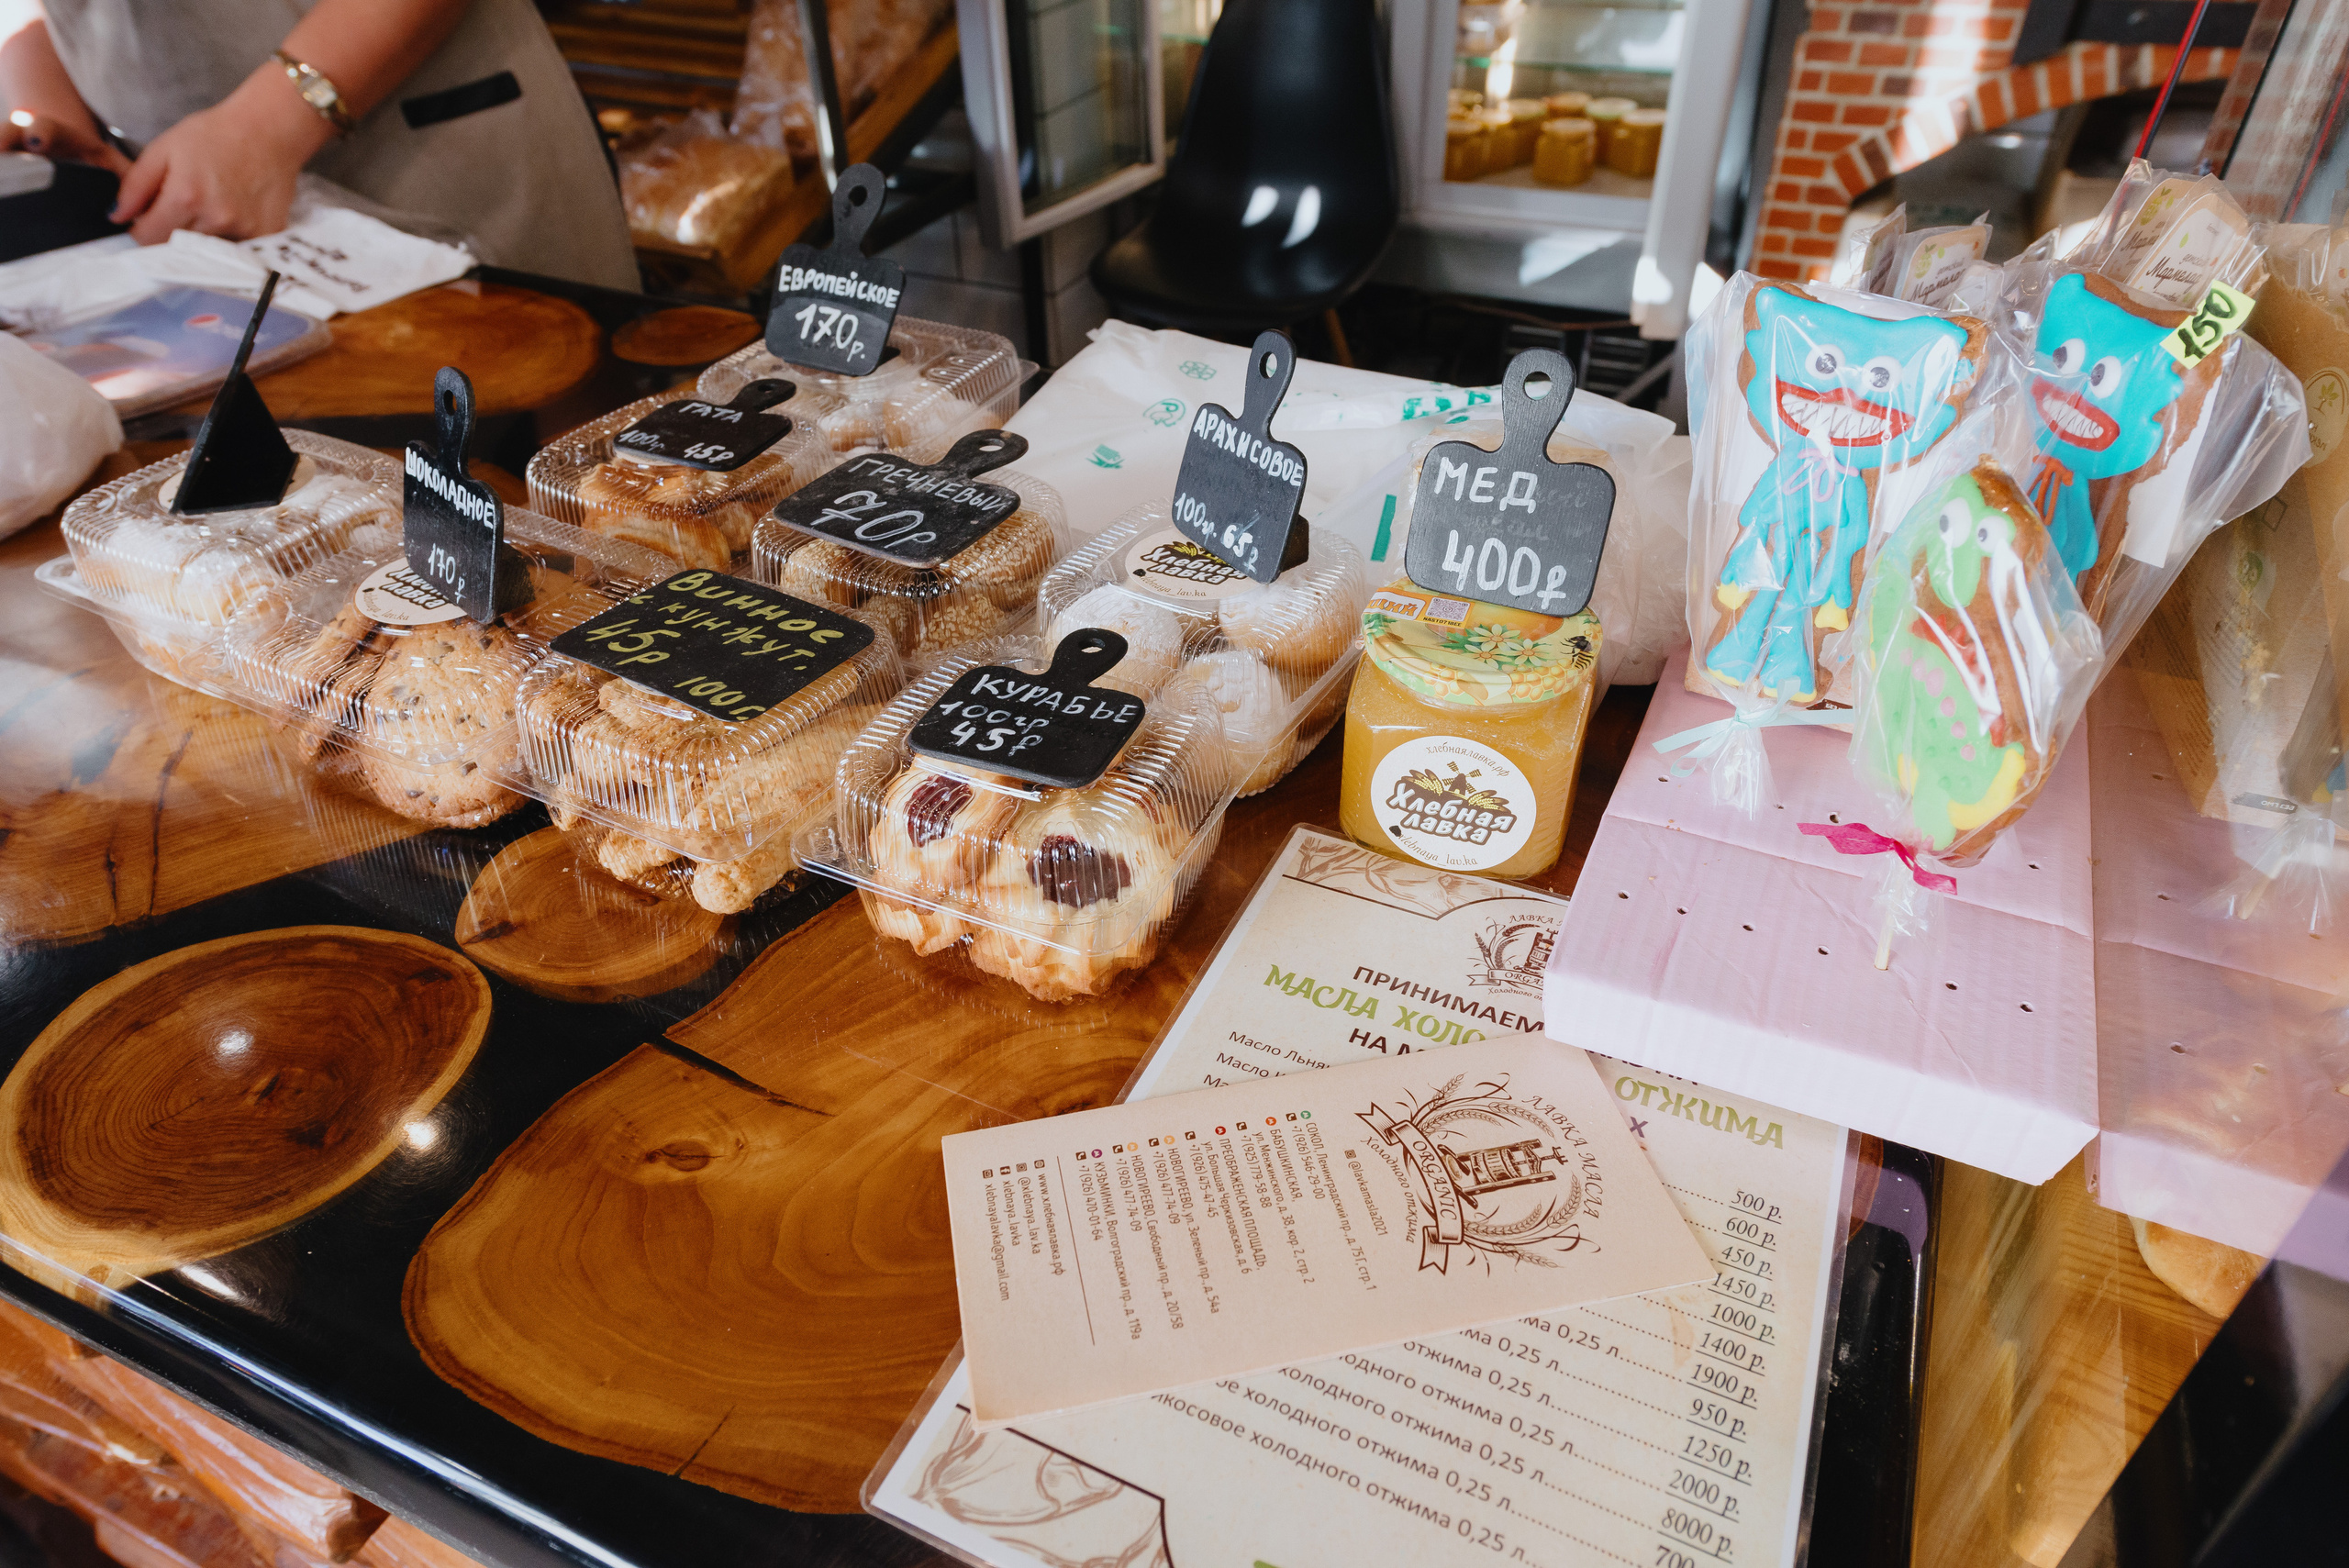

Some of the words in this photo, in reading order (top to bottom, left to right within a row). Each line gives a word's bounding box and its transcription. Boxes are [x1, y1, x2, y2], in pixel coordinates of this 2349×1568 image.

[778, 264, 900, 308] ЕВРОПЕЙСКОЕ
[679, 402, 743, 423] ГАТА
[1194, 408, 1304, 486] АРАХИСОВОЕ
[406, 447, 495, 529] ШОКОЛАДНОЕ
[1433, 457, 1537, 513] МЕД
[971, 673, 1139, 724] КУРАБЬЕ
[1388, 783, 1514, 831] Хлебная
[1403, 813, 1489, 844] лавка
[1264, 964, 1378, 1019] МАСЛА
[1505, 972, 1543, 985] ORGA
[1216, 1052, 1270, 1079] Масло
[1229, 1031, 1282, 1056] Масло
[1349, 1029, 1387, 1053] НА
[1614, 1076, 1783, 1150] ОТЖИМА
[1208, 1153, 1225, 1193] Большая
[1219, 1138, 1252, 1218] ПРЕОБРАЖЕНСКАЯ
[1306, 1122, 1324, 1152] СОКОЛ,
[1317, 1153, 1348, 1218] Ленинградский
[1412, 1140, 1458, 1220] ORGANIC
[1521, 1095, 1587, 1148] ЛАВКА
[1578, 1151, 1604, 1219] МАСЛА
[1348, 1161, 1388, 1236] @lavkamasla2021
[1360, 1136, 1409, 1189] Холодного
[1404, 1192, 1419, 1243] отжима
[1731, 1190, 1765, 1212] 500
[985, 1184, 1010, 1301] xlebnayalavka@gmail.com
[1107, 1219, 1130, 1288] Волгоградский
[1146, 1219, 1168, 1271] Свободный
[1188, 1226, 1208, 1266] Зеленый
[1726, 1217, 1758, 1239] 600
[1721, 1246, 1755, 1267] 450
[1711, 1273, 1757, 1299] 1450
[1710, 1303, 1756, 1331] 1000
[1557, 1323, 1600, 1351] 0,25
[1690, 1363, 1738, 1393] 1900
[1699, 1332, 1746, 1362] 1400
[1404, 1341, 1482, 1378] отжима
[1488, 1370, 1531, 1397] 0,25
[1682, 1436, 1731, 1468] 1250
[1498, 1337, 1541, 1364] 0,25
[1689, 1398, 1728, 1427] 950
[1243, 1387, 1352, 1442] холодного
[1357, 1436, 1439, 1480] отжима
[1445, 1471, 1492, 1503] 0,25
[1422, 1385, 1503, 1425] отжима
[1509, 1417, 1554, 1446] 0,25
[1669, 1470, 1720, 1504] 2000
[1250, 1431, 1361, 1488] холодного
[1366, 1483, 1451, 1529] отжима
[1457, 1519, 1506, 1552] 0,25
[1391, 1411, 1473, 1453] отжима
[1479, 1444, 1525, 1474] 0,25
[1661, 1508, 1713, 1545] 8000
